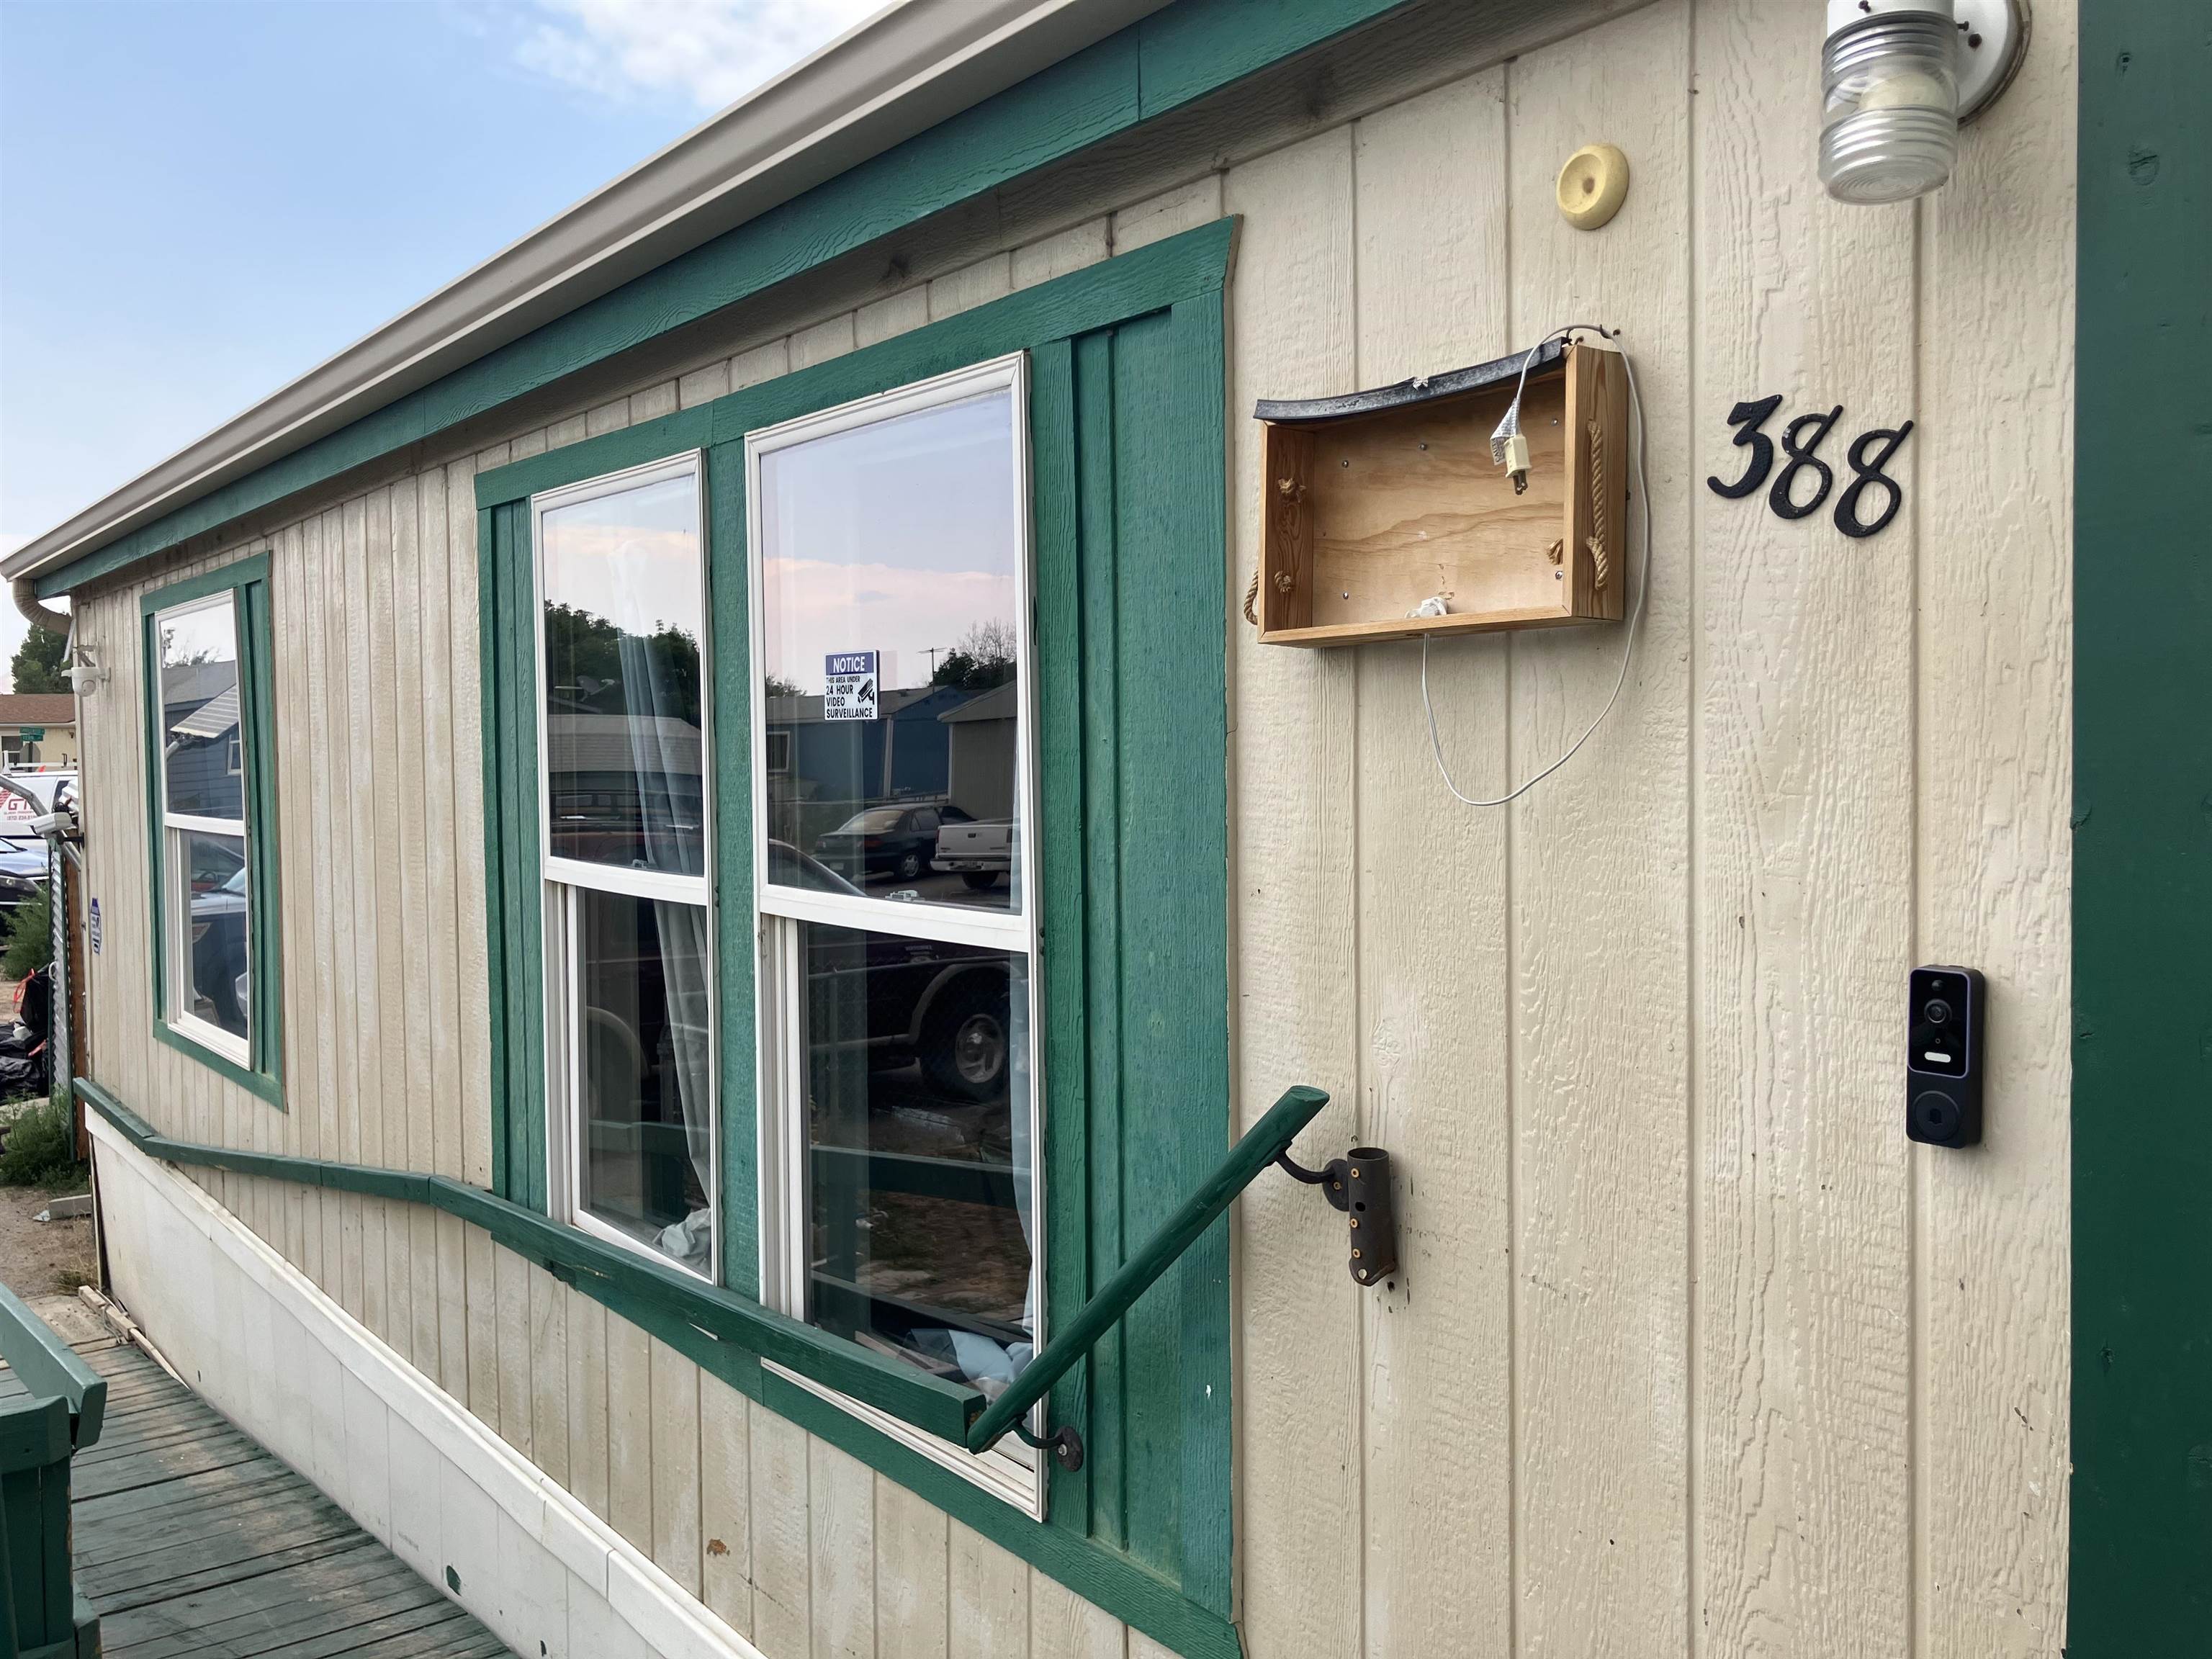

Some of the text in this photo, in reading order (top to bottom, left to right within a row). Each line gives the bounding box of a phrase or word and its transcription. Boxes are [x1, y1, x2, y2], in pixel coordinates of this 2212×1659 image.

[1707, 394, 1914, 538] 388
[833, 656, 866, 673] NOTICE
[826, 685, 853, 696] 24 HOUR
[826, 696, 845, 706] VIDEO
[826, 708, 873, 719] SURVEILLANCE
